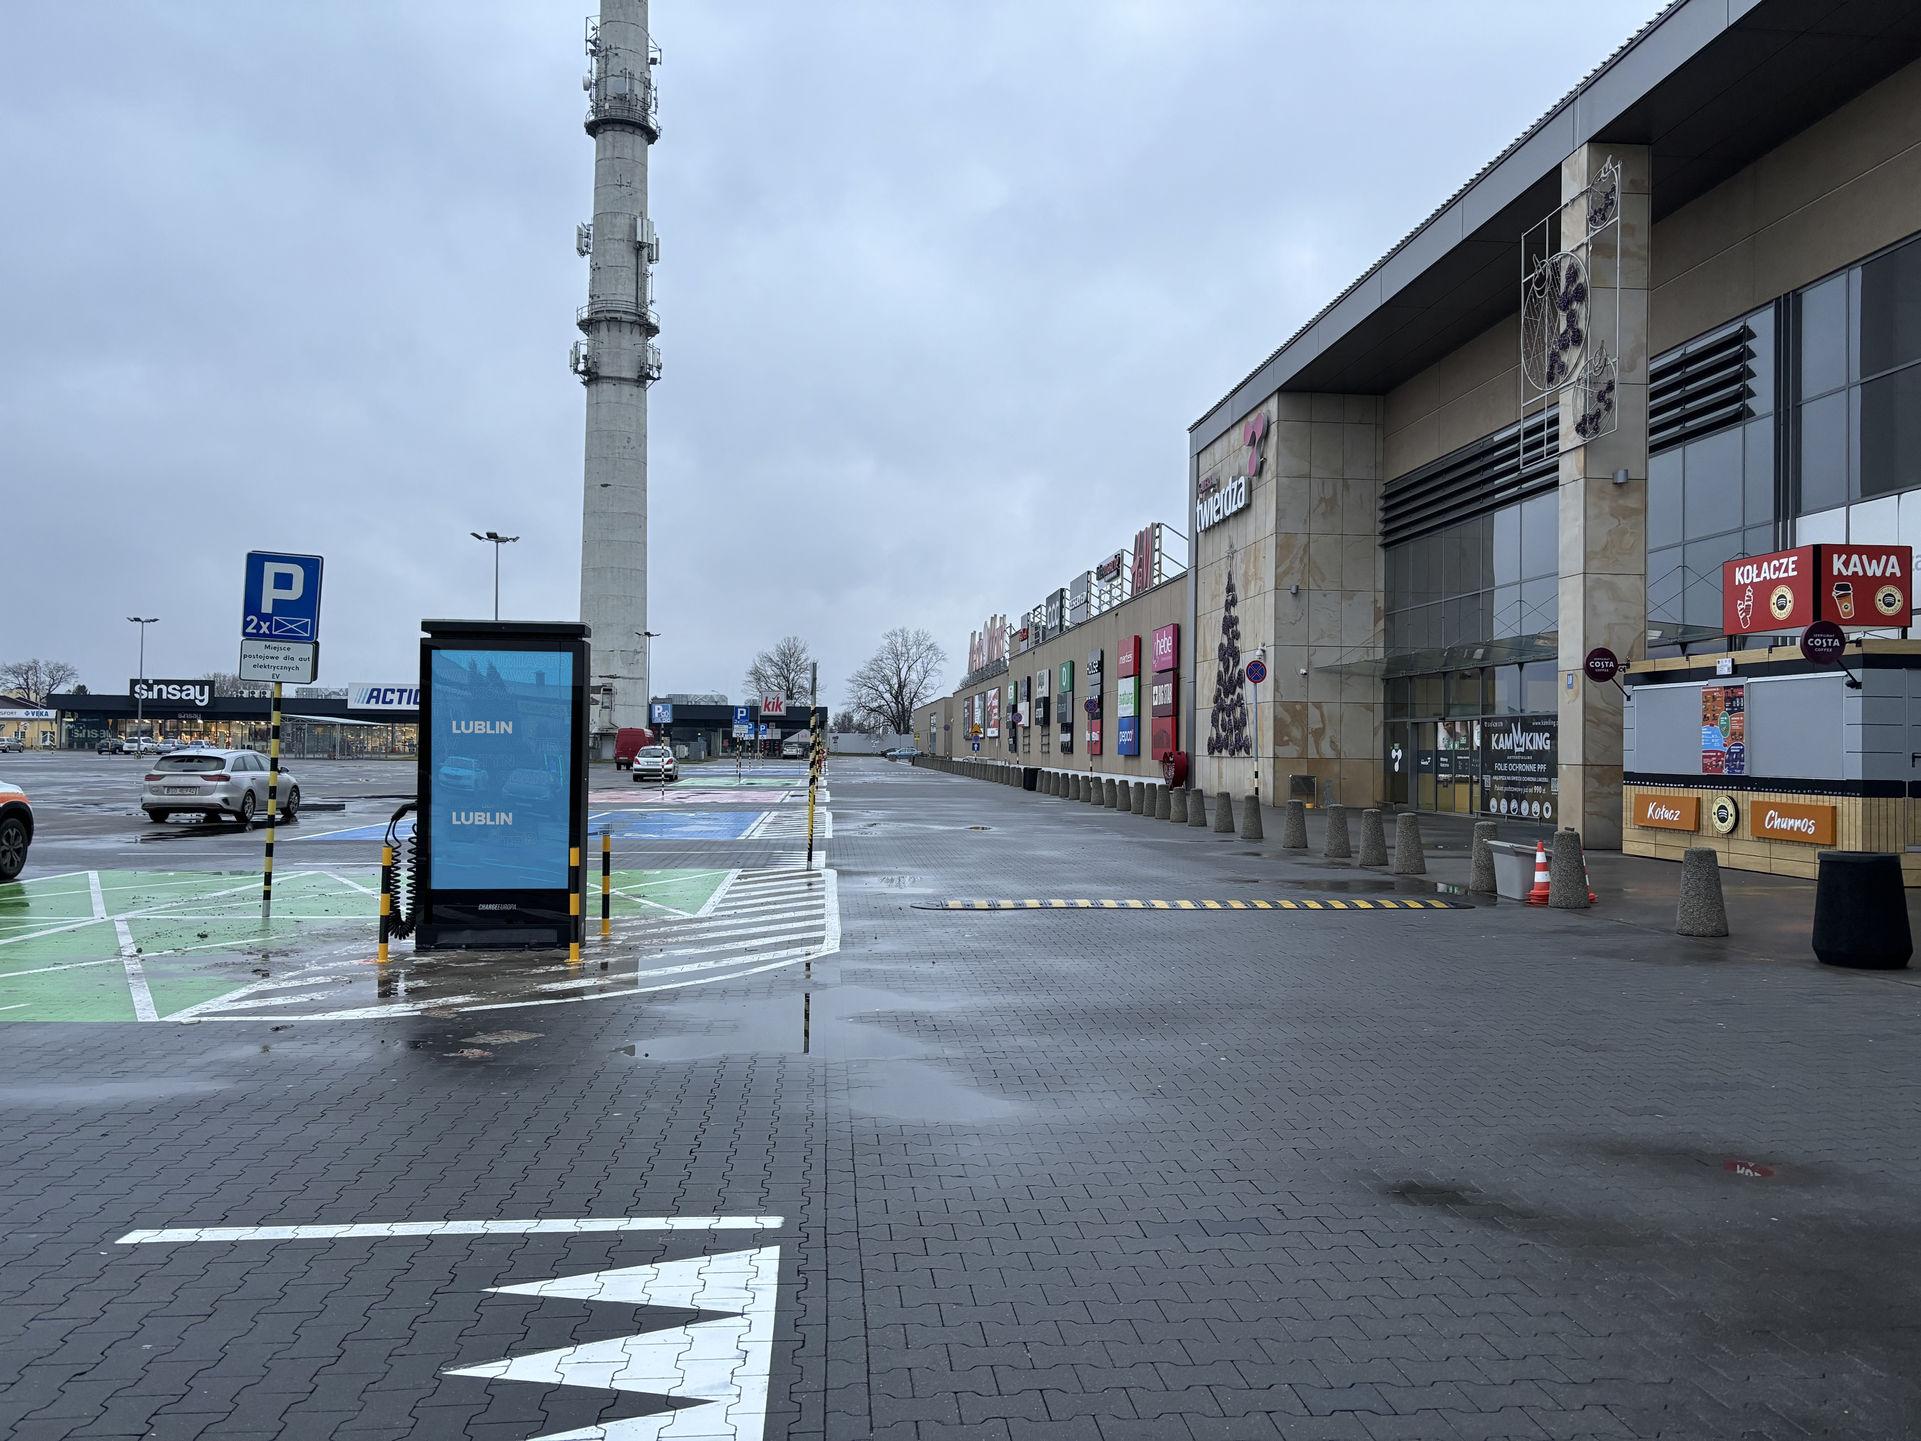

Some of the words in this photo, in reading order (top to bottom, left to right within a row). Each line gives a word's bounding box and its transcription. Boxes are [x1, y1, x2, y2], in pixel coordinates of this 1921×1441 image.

[1196, 476, 1245, 533] twierdza
[1735, 556, 1798, 586] KOŁACZE
[1832, 553, 1902, 578] KAWA
[261, 562, 304, 614] P
[264, 644, 292, 652] Miejsce
[1156, 630, 1172, 656] hebe
[1808, 638, 1840, 648] COSTA
[243, 653, 280, 661] postojowe
[252, 662, 300, 672] elektrycznych
[134, 680, 210, 706] sinsay
[655, 705, 662, 718] P
[738, 708, 746, 720] P
[452, 721, 512, 734] LUBLIN
[1509, 764, 1536, 772] OCHRONNE
[1537, 764, 1546, 772] PPF
[1646, 802, 1680, 821] Kołacz
[452, 812, 512, 825] LUBLIN
[1764, 810, 1816, 834] Churros
